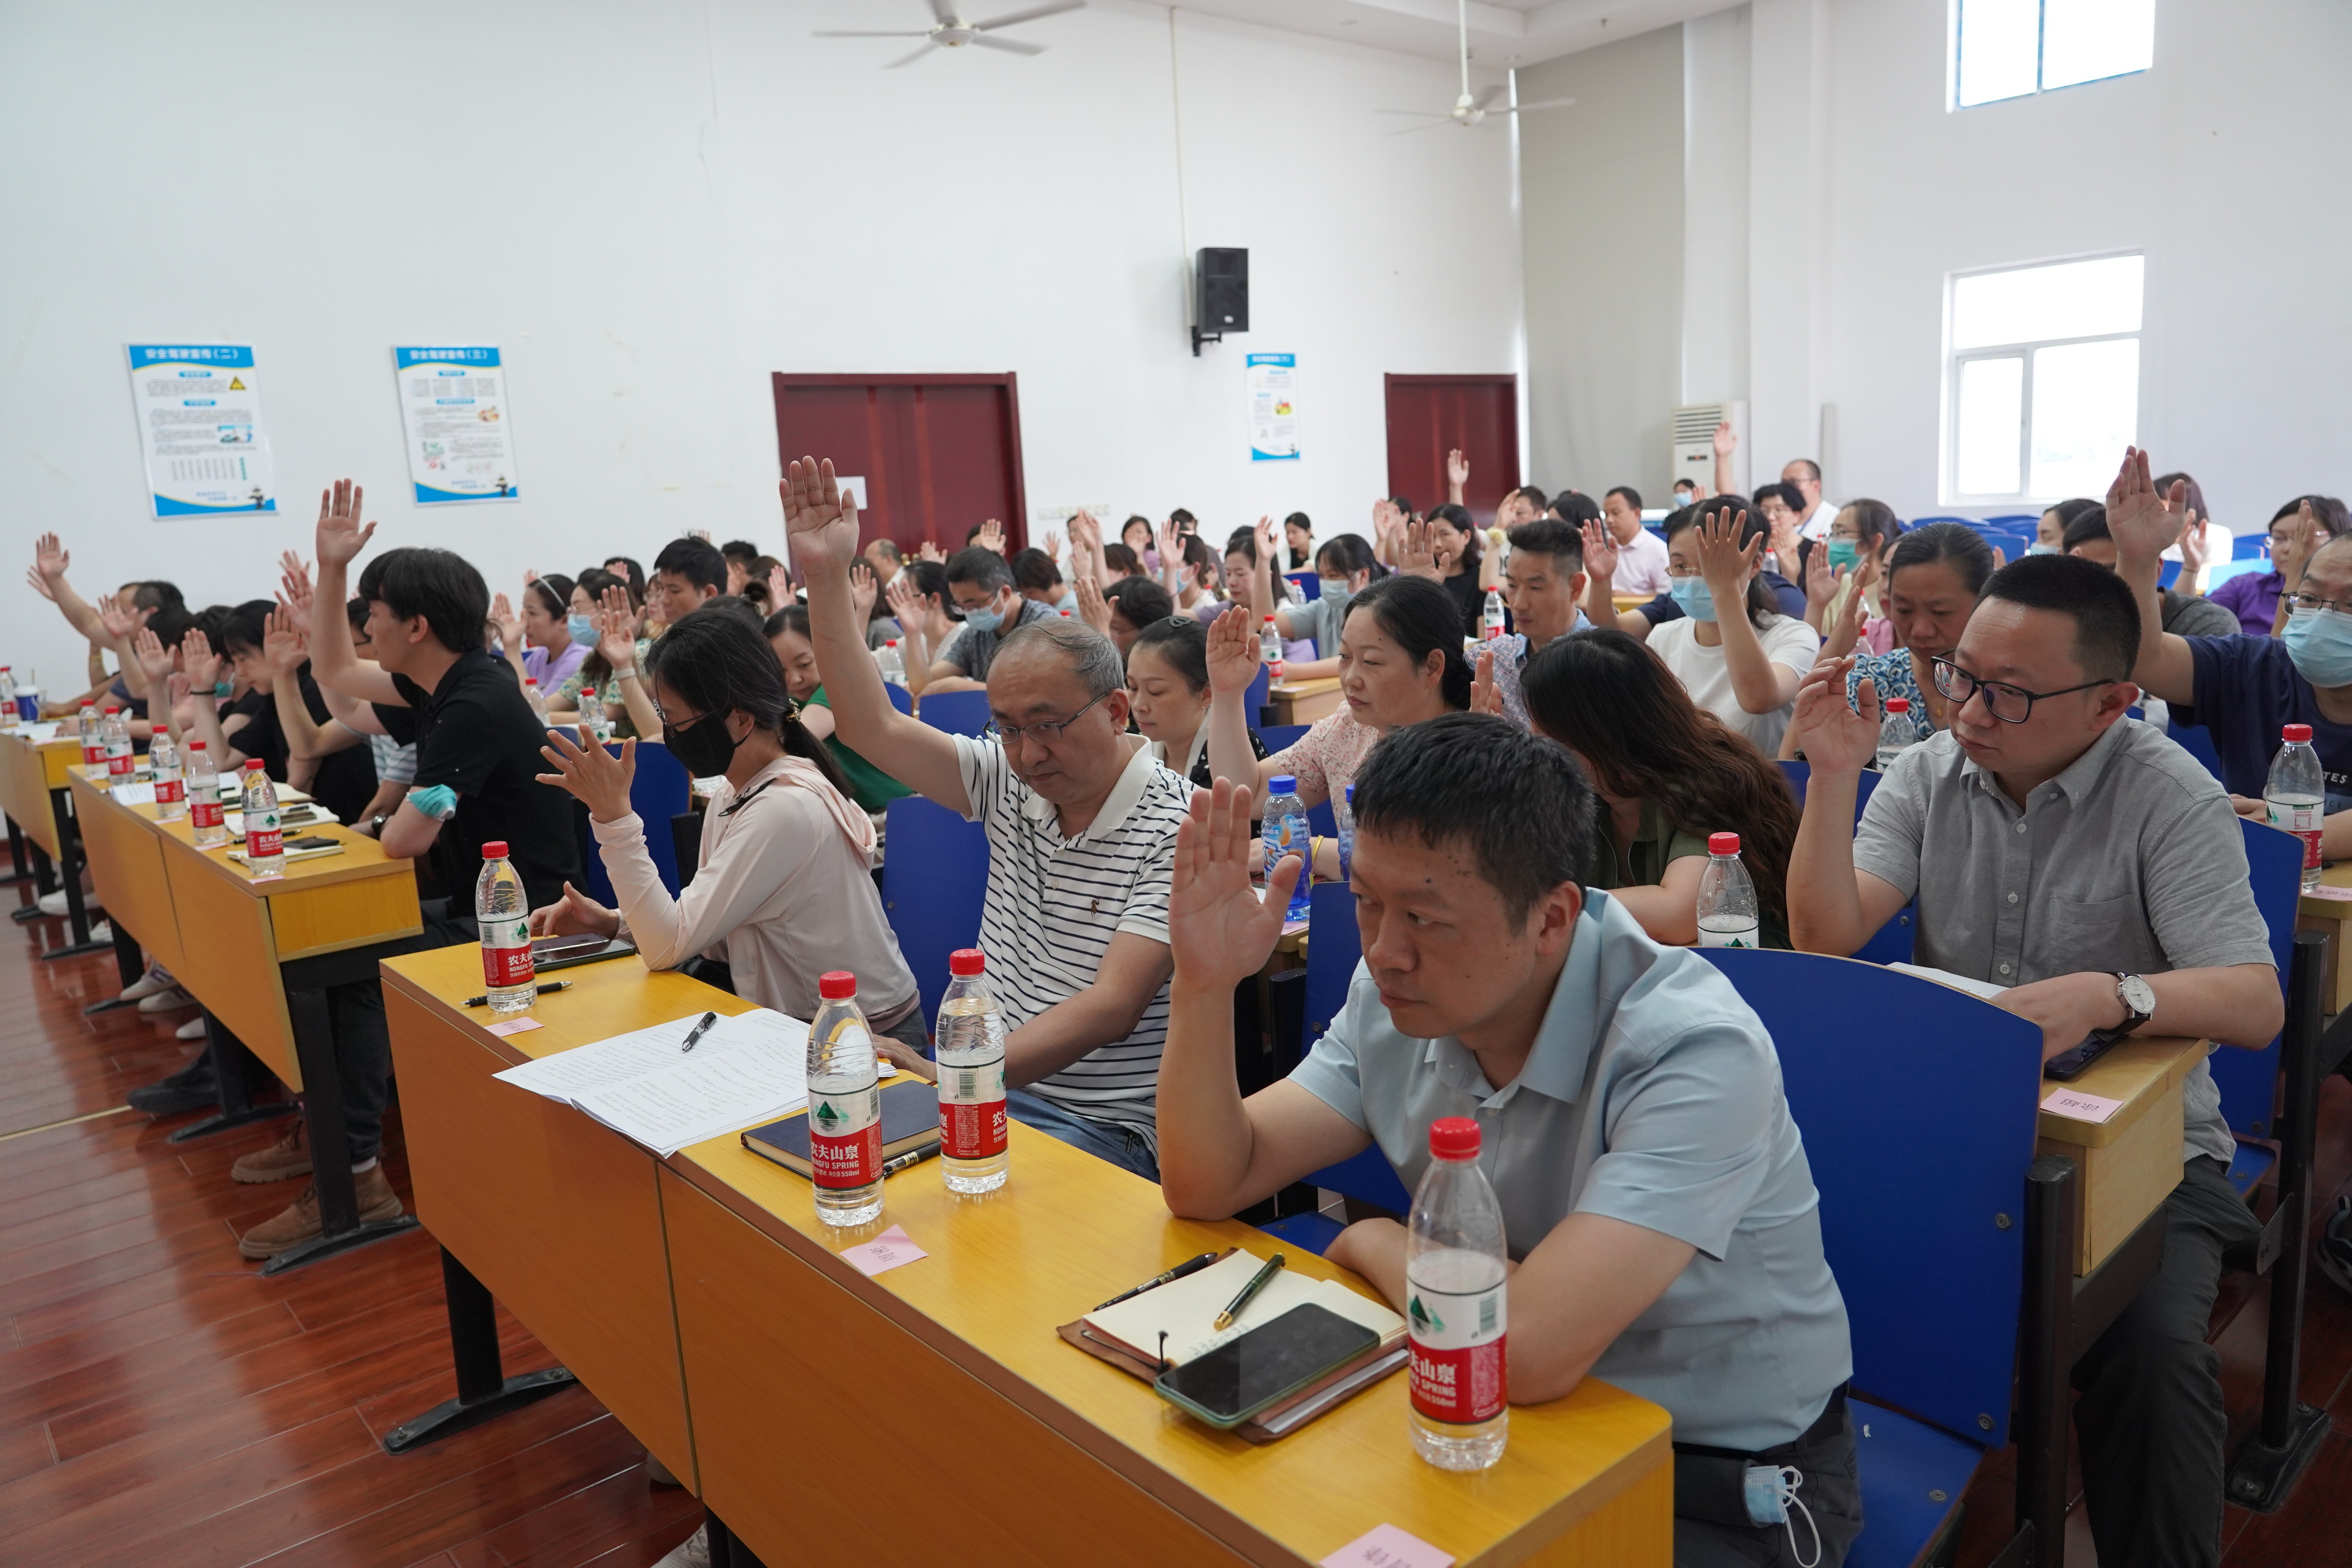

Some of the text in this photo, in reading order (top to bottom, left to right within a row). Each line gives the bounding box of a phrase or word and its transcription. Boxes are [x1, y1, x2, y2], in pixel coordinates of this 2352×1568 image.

[2323, 771, 2348, 784] TES
[508, 950, 533, 966] 农夫山
[509, 963, 528, 972] NONGFU
[813, 1157, 859, 1169] ONGFU SPRING
[1410, 1350, 1456, 1384] 夫山泉
[1421, 1378, 1456, 1397] SPRING
